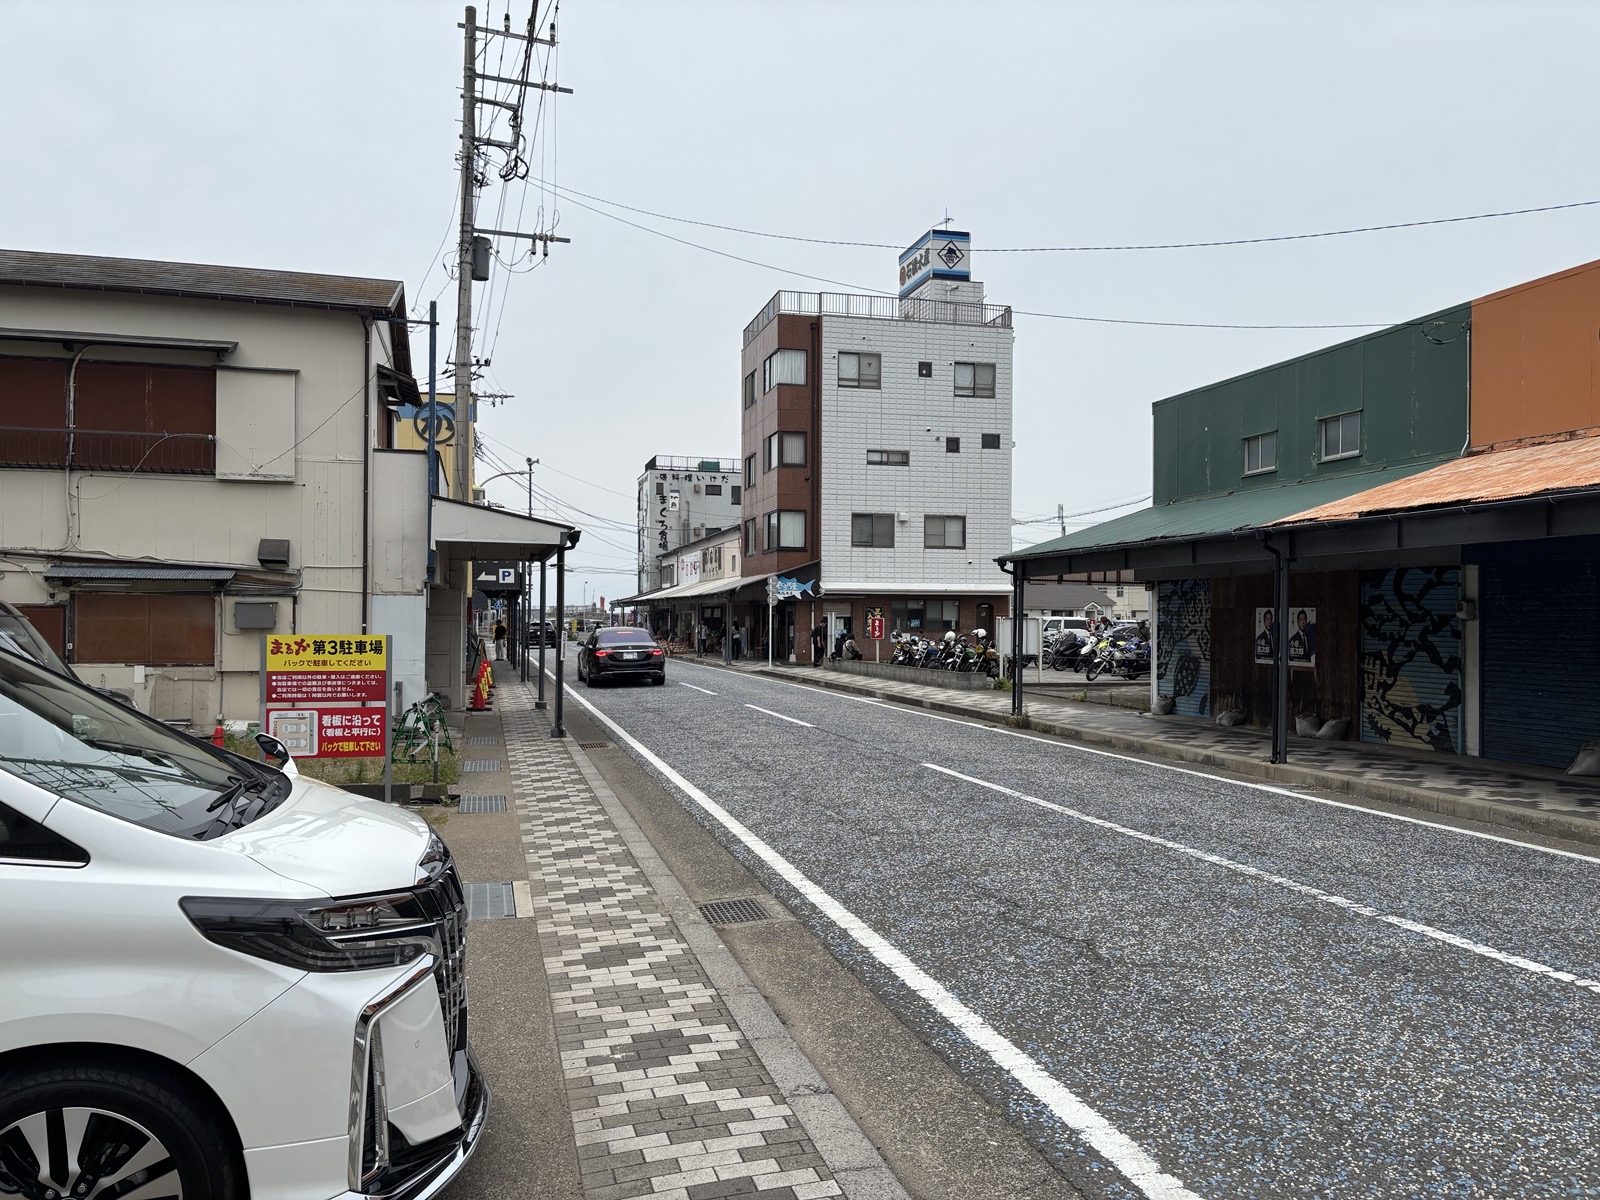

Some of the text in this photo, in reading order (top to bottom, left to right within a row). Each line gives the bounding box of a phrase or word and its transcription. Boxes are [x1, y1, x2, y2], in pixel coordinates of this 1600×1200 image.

[502, 570, 512, 582] P
[270, 638, 383, 656] まるか 第3駐車場
[283, 659, 372, 667] バックで駐車してください
[321, 715, 381, 726] 看板に沿って
[321, 727, 381, 737] (看板と平行に)
[321, 741, 381, 752] バックで駐車して下さい
